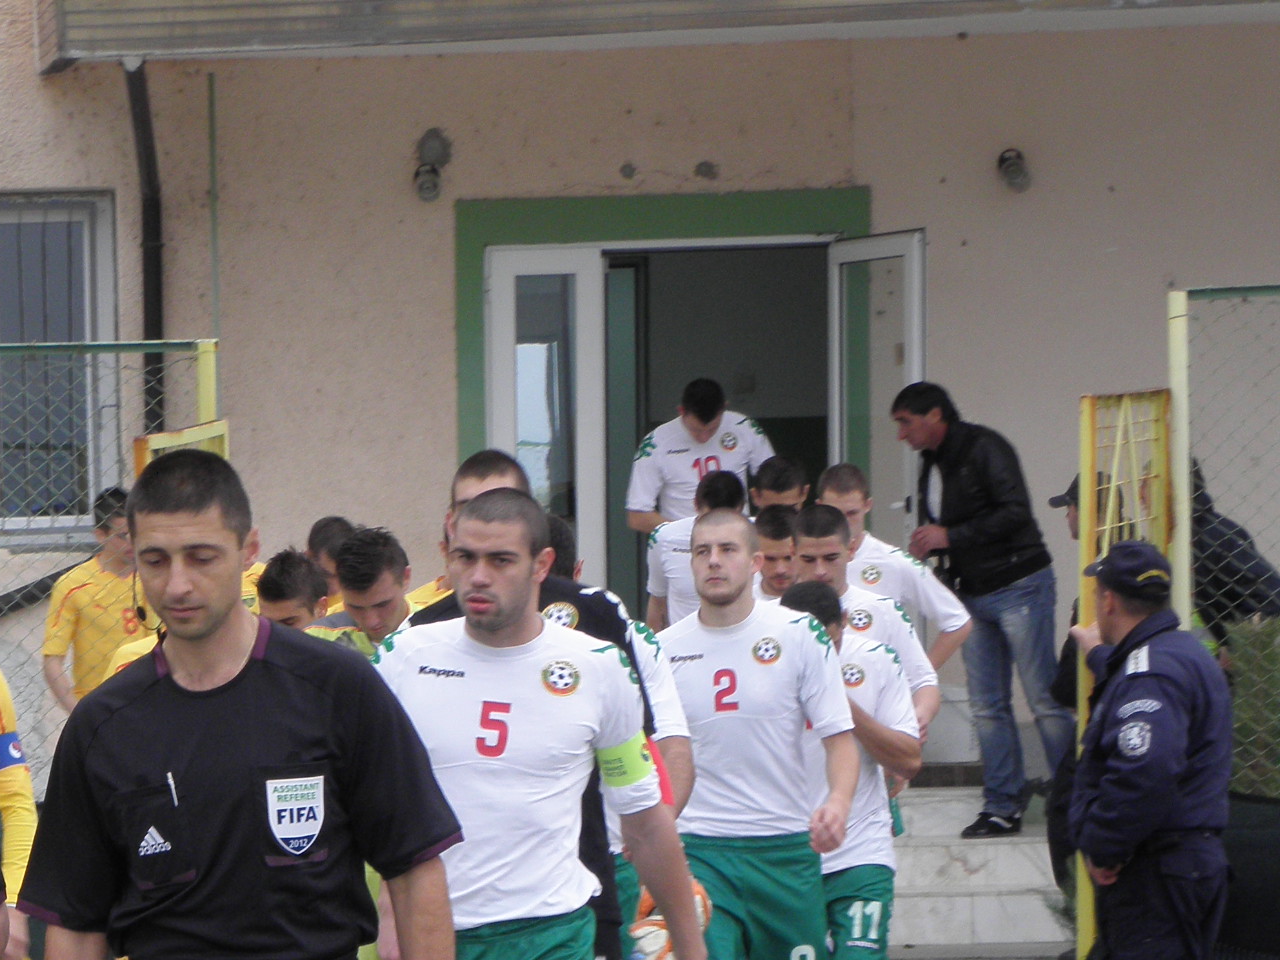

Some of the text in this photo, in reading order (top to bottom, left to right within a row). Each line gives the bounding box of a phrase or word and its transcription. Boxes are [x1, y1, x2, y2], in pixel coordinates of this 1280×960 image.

[121, 608, 138, 636] 8
[418, 665, 465, 678] Kappa
[713, 668, 740, 713] 2
[475, 700, 512, 758] 5
[272, 782, 320, 794] ASSISTANT
[276, 791, 317, 803] REFEREE
[276, 805, 318, 825] FIFA
[138, 841, 172, 857] adidas
[288, 838, 309, 849] 2012
[846, 900, 883, 940] 11
